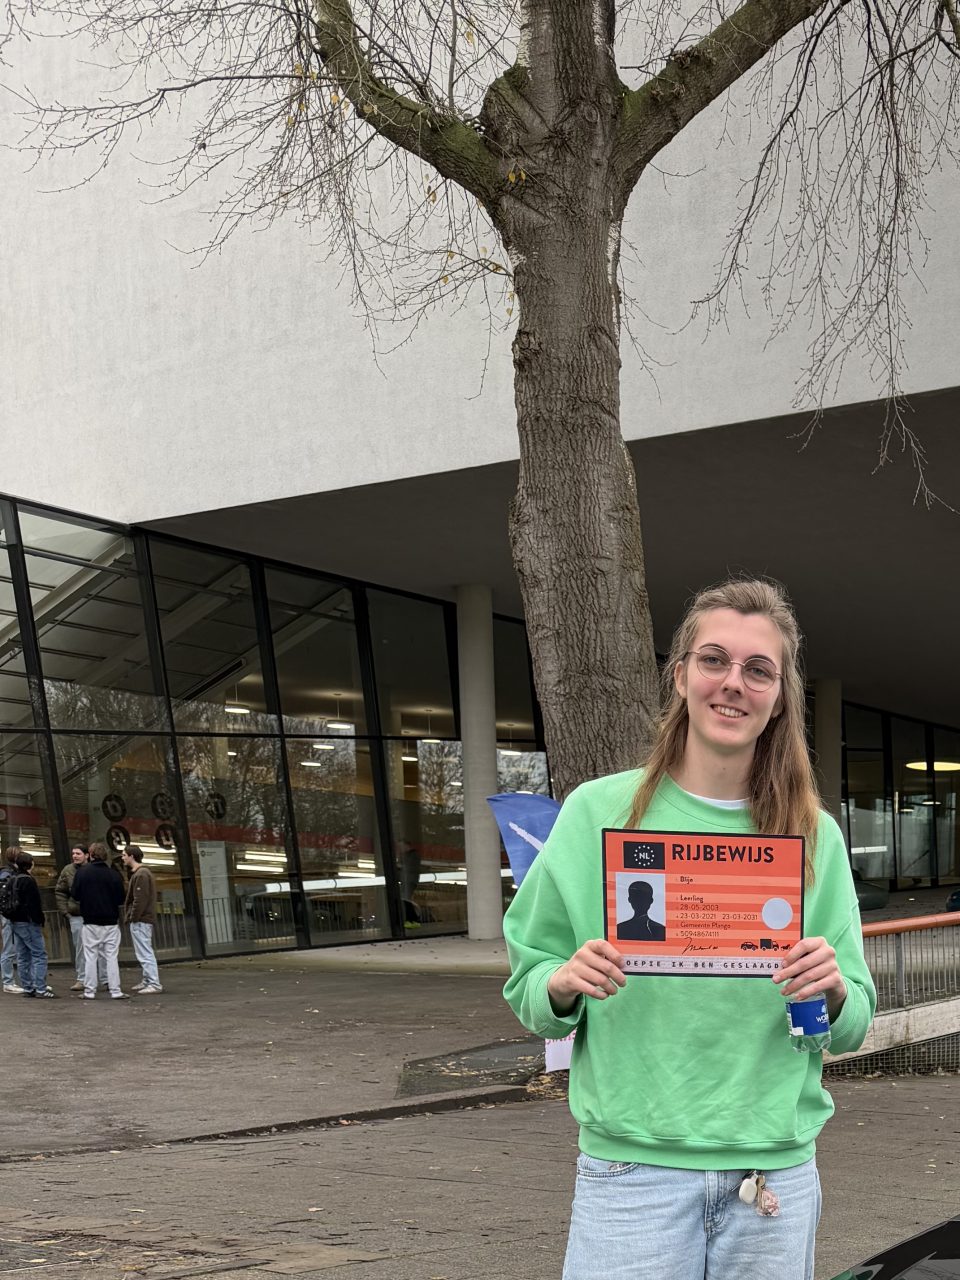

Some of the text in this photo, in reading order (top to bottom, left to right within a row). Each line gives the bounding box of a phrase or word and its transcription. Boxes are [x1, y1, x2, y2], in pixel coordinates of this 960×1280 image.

[639, 852, 651, 860] NL
[671, 843, 775, 863] RIJBEWIJS
[680, 894, 704, 904] Leerling
[626, 960, 661, 968] OEPIE
[694, 961, 713, 969] BEN
